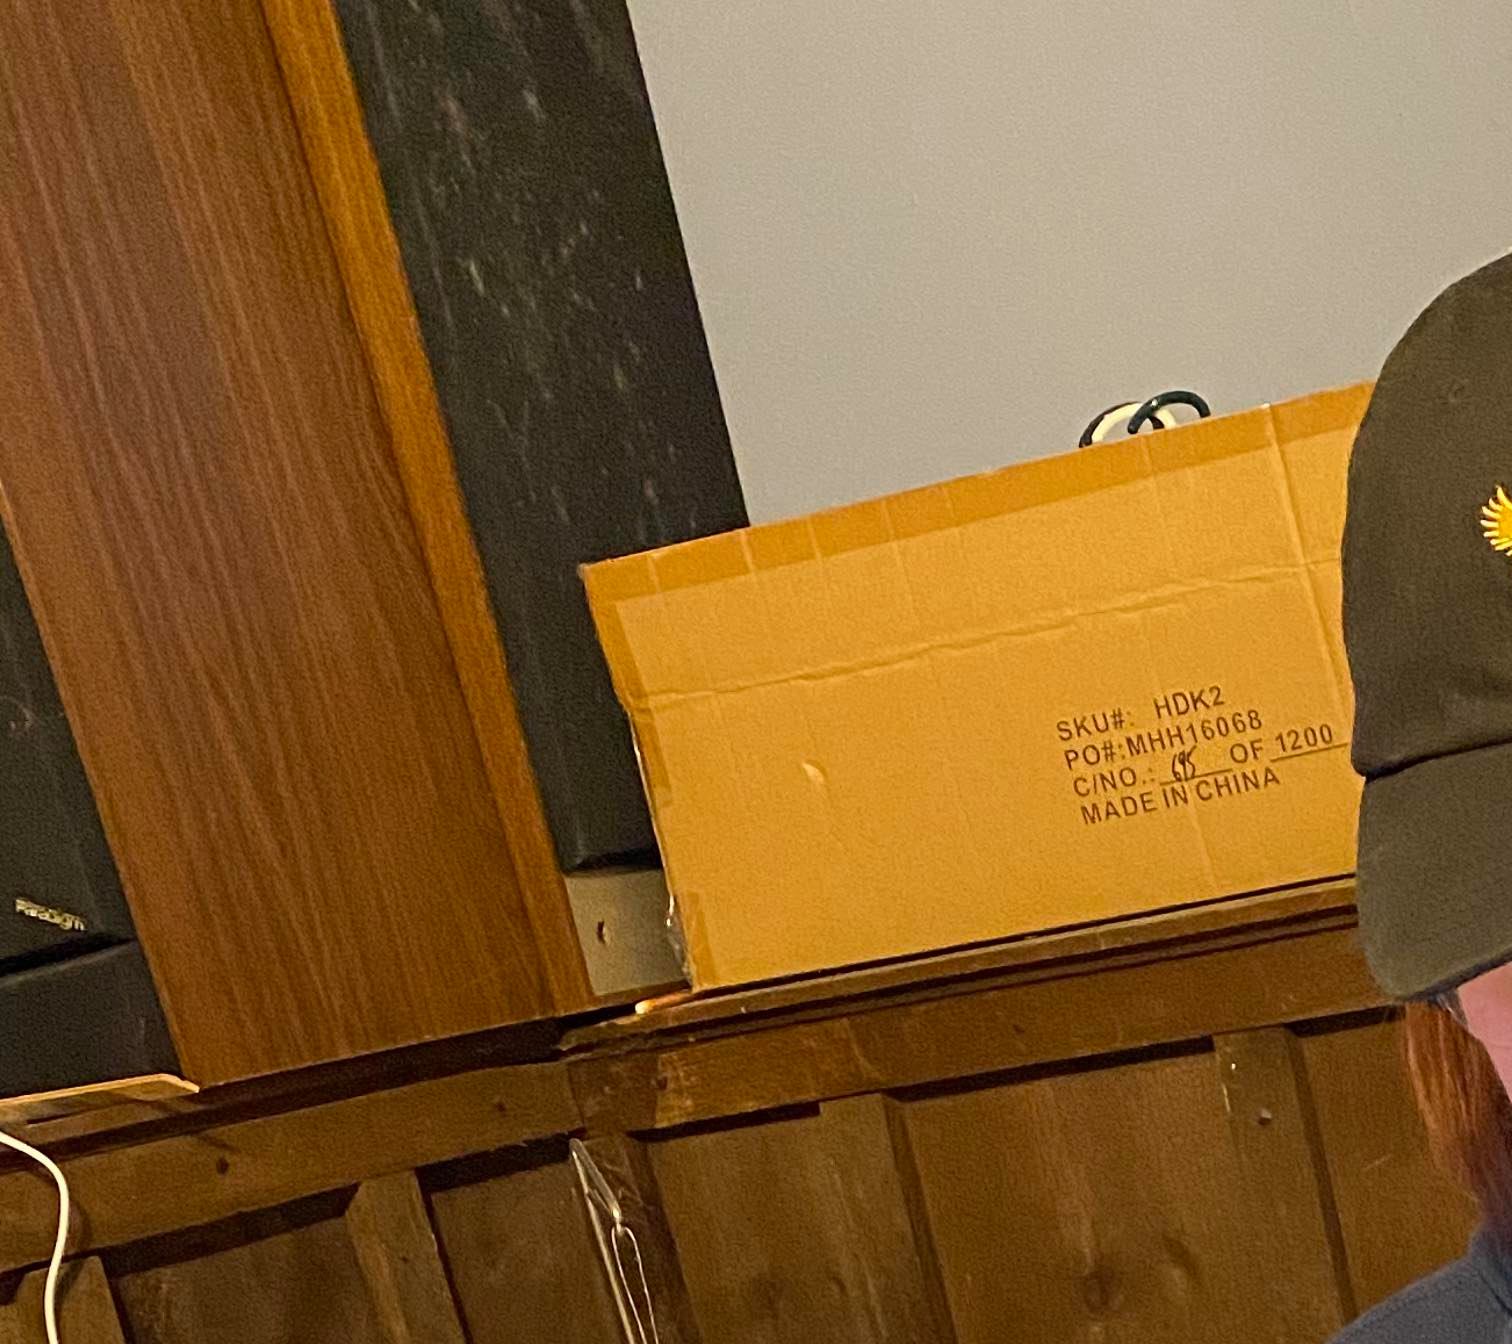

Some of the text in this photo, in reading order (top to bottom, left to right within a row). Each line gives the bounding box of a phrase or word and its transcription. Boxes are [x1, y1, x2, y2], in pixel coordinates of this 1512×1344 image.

[1056, 685, 1225, 742] SKU#: HDK2
[1229, 739, 1265, 764] OF
[1275, 723, 1334, 754] 1200
[1080, 766, 1280, 825] MADE IN CHINA
